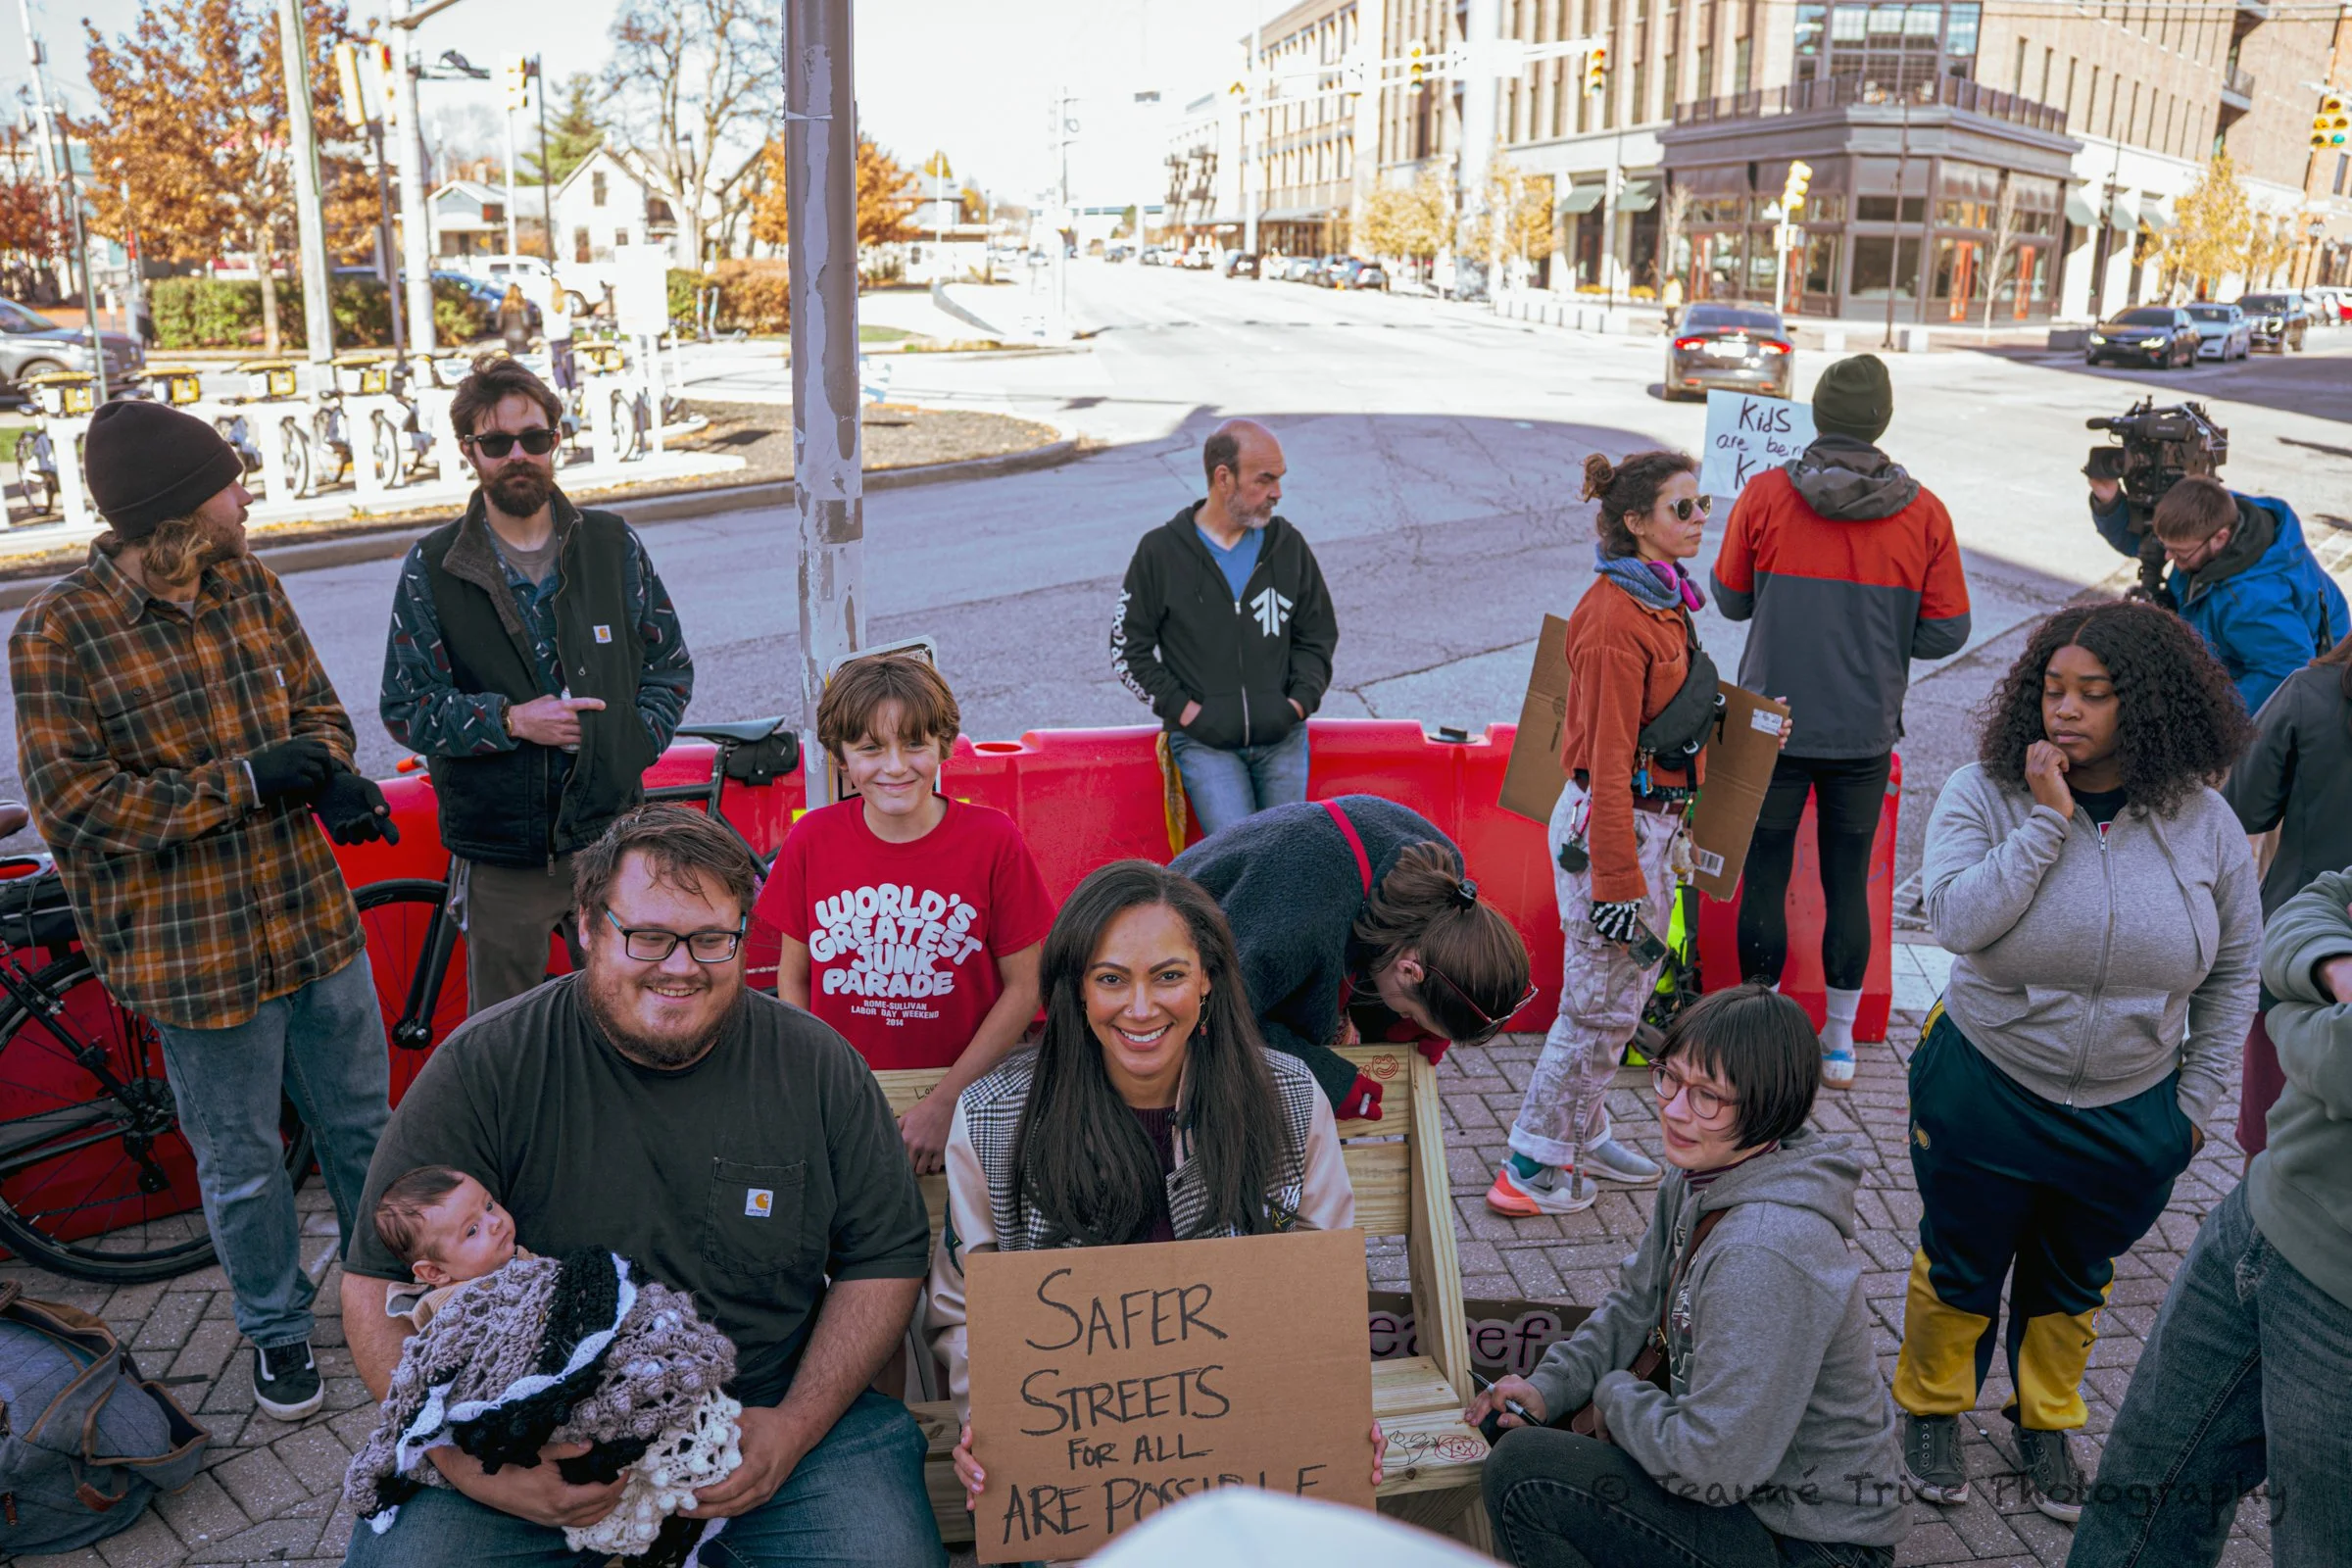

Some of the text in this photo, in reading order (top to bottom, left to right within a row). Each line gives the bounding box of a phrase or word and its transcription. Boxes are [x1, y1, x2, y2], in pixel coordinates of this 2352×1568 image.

[1717, 434, 1749, 451] are
[814, 883, 978, 933] WORLD'S
[808, 914, 983, 965] GREATEST
[851, 943, 939, 975] JUNK
[822, 968, 955, 998] PARADE
[851, 1005, 939, 1019] LABOR DAY WEEKEND
[863, 1000, 927, 1010] ROME-SULLIVAN
[1025, 1268, 1228, 1355] SAFER
[1020, 1365, 1230, 1436] STREETS
[1068, 1434, 1213, 1470] FOR ALL
[1003, 1484, 1091, 1544] ARE
